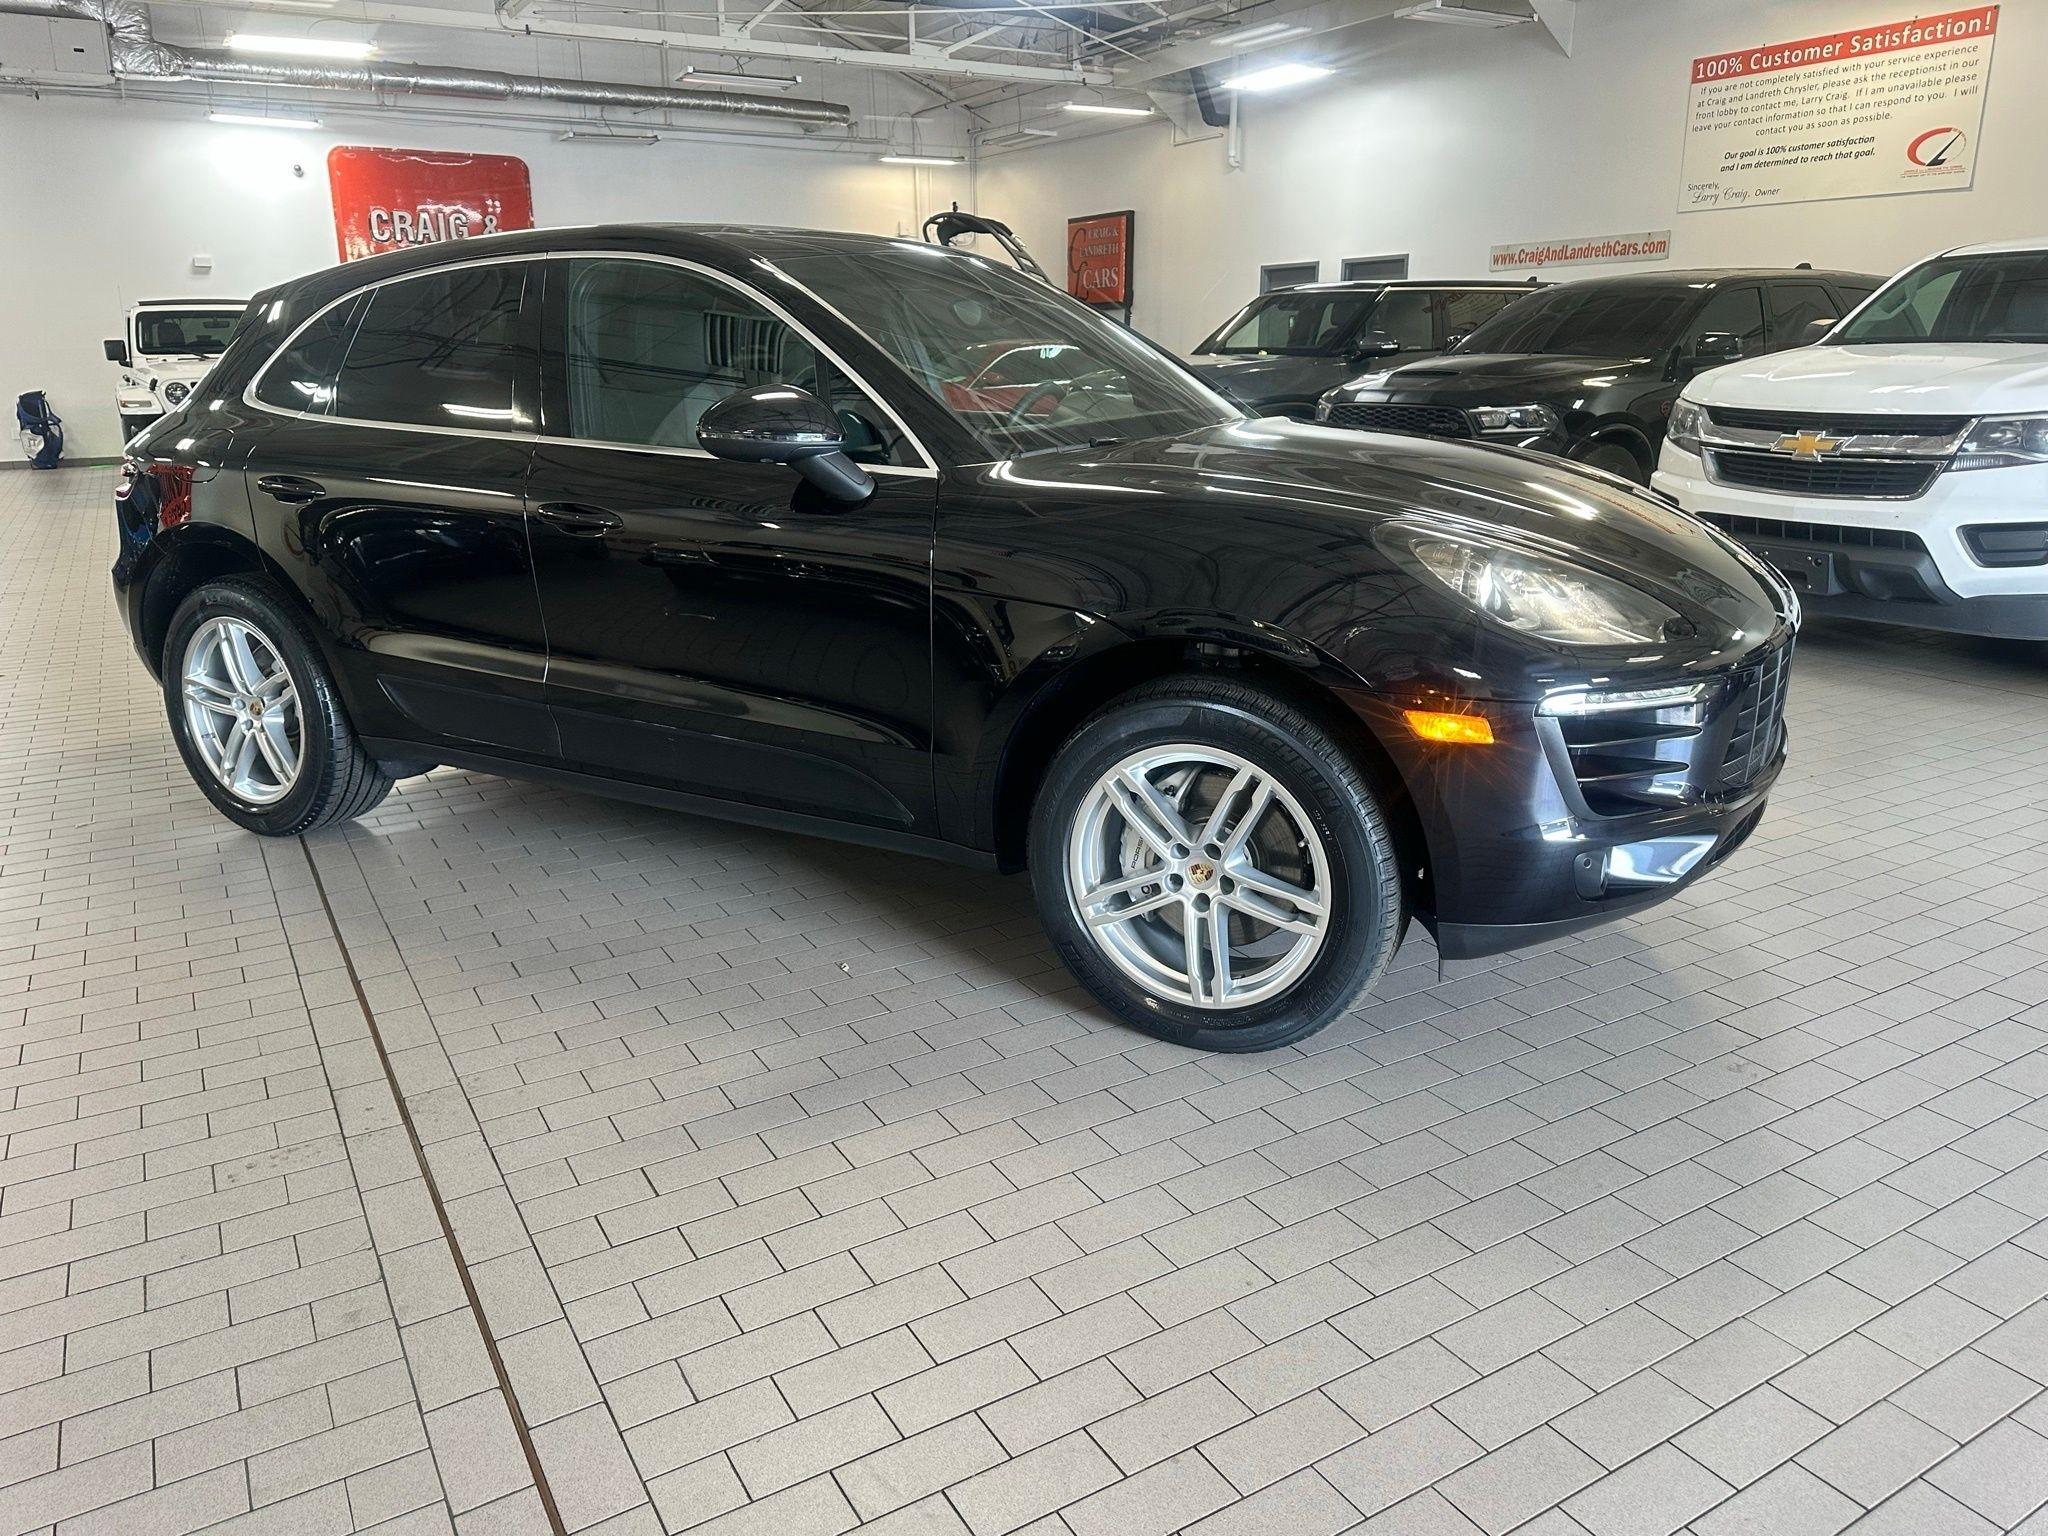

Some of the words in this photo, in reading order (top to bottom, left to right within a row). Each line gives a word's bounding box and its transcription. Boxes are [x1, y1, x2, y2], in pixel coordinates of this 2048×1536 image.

[1696, 56, 1743, 79] 100%
[1750, 41, 1843, 70] Customer
[1849, 10, 1992, 54] Satisfaction!
[1700, 86, 1707, 95] If
[1708, 86, 1722, 95] you
[1740, 80, 1753, 88] not
[1755, 73, 1800, 86] completely
[1803, 66, 1839, 79] satisfied
[1842, 62, 1861, 73] with
[1864, 60, 1885, 71] your
[1888, 54, 1921, 66] service
[1924, 45, 1979, 61] experience
[1707, 97, 1727, 106] Craig
[1728, 94, 1743, 103] and
[1745, 88, 1782, 101] Landreth
[1783, 83, 1819, 95] Chrysler,
[1822, 78, 1851, 91] please
[1853, 75, 1868, 84] ask
[1871, 72, 1886, 82] the
[1889, 63, 1947, 79] receptionist
[1949, 60, 1959, 71] in
[1961, 58, 1980, 68] our
[1692, 123, 1712, 133] leave
[1714, 121, 1732, 131] your
[1733, 116, 1763, 127] contact
[1765, 109, 1814, 123] information
[1816, 107, 1826, 115] so
[1829, 104, 1847, 114] that
[1854, 101, 1871, 110] can
[1873, 94, 1911, 108] respond
[1914, 94, 1924, 102] to
[1927, 92, 1947, 102] you.
[1960, 84, 1978, 95] will
[1695, 111, 1714, 120] front
[1716, 108, 1738, 117] lobby
[1740, 106, 1749, 114] to
[1751, 101, 1781, 112] contact
[1783, 99, 1798, 108] me,
[1801, 95, 1824, 105] Larry
[1870, 86, 1885, 95] am
[1887, 78, 1942, 93] unavailable
[1945, 73, 1977, 86] please
[1755, 125, 1786, 136] contact
[1788, 123, 1803, 133] you
[1805, 122, 1815, 130] as
[1817, 119, 1838, 129] soon
[1840, 117, 1850, 125] as
[1852, 111, 1893, 125] possible.
[1720, 163, 1735, 172] and
[1740, 162, 1753, 170] am
[1754, 156, 1799, 169] determined
[1800, 156, 1809, 164] to
[1810, 152, 1833, 162] reach
[1834, 151, 1853, 160] that
[1854, 147, 1876, 159] goal.
[1724, 151, 1738, 160] Our
[1739, 148, 1757, 159] goal
[1758, 147, 1764, 156] is
[1765, 145, 1787, 155] 100%
[1788, 141, 1826, 152] customer
[1826, 135, 1875, 148] satisfaction
[1687, 181, 1720, 192] Sincerely,
[1690, 191, 1720, 206] Larry
[1754, 188, 1781, 197] Owner
[369, 207, 470, 243] CRAIG
[483, 213, 500, 235] &
[1088, 226, 1112, 239] CRAIG
[1079, 242, 1119, 258] LANDRETH
[1492, 239, 1668, 267] www.CraigAndLandrethCars.com
[1082, 267, 1119, 289] CARS
[1237, 718, 1344, 809] MICHELIN
